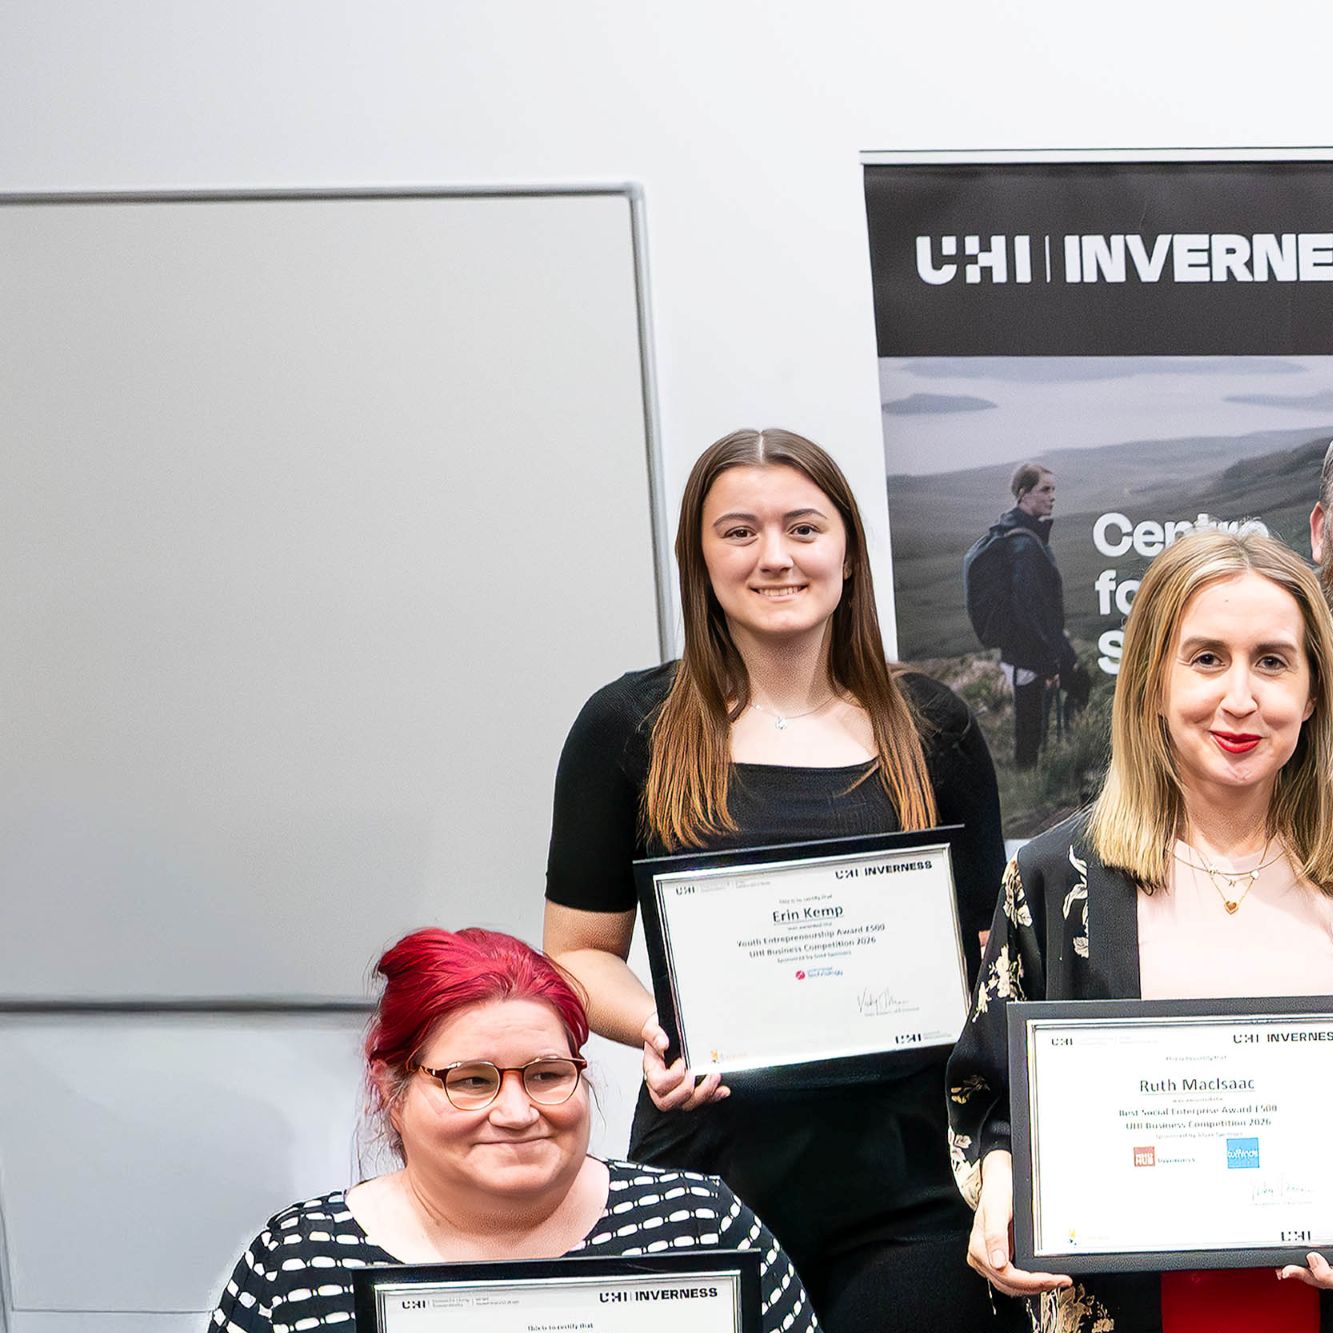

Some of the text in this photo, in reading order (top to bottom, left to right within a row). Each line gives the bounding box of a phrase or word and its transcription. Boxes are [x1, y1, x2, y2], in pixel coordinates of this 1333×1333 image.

[917, 234, 1031, 285] UHI
[835, 860, 932, 880] UHI INVERNESS
[676, 886, 695, 895] UHI
[773, 906, 843, 922] Erin Kemp
[895, 1034, 922, 1044] UHI
[1051, 1037, 1073, 1046] UHI
[1233, 1034, 1259, 1044] UHI
[1140, 1078, 1255, 1092] Ruth MacIsaac
[600, 1287, 718, 1303] UHI INVERNESS
[402, 1300, 425, 1309] UHI
